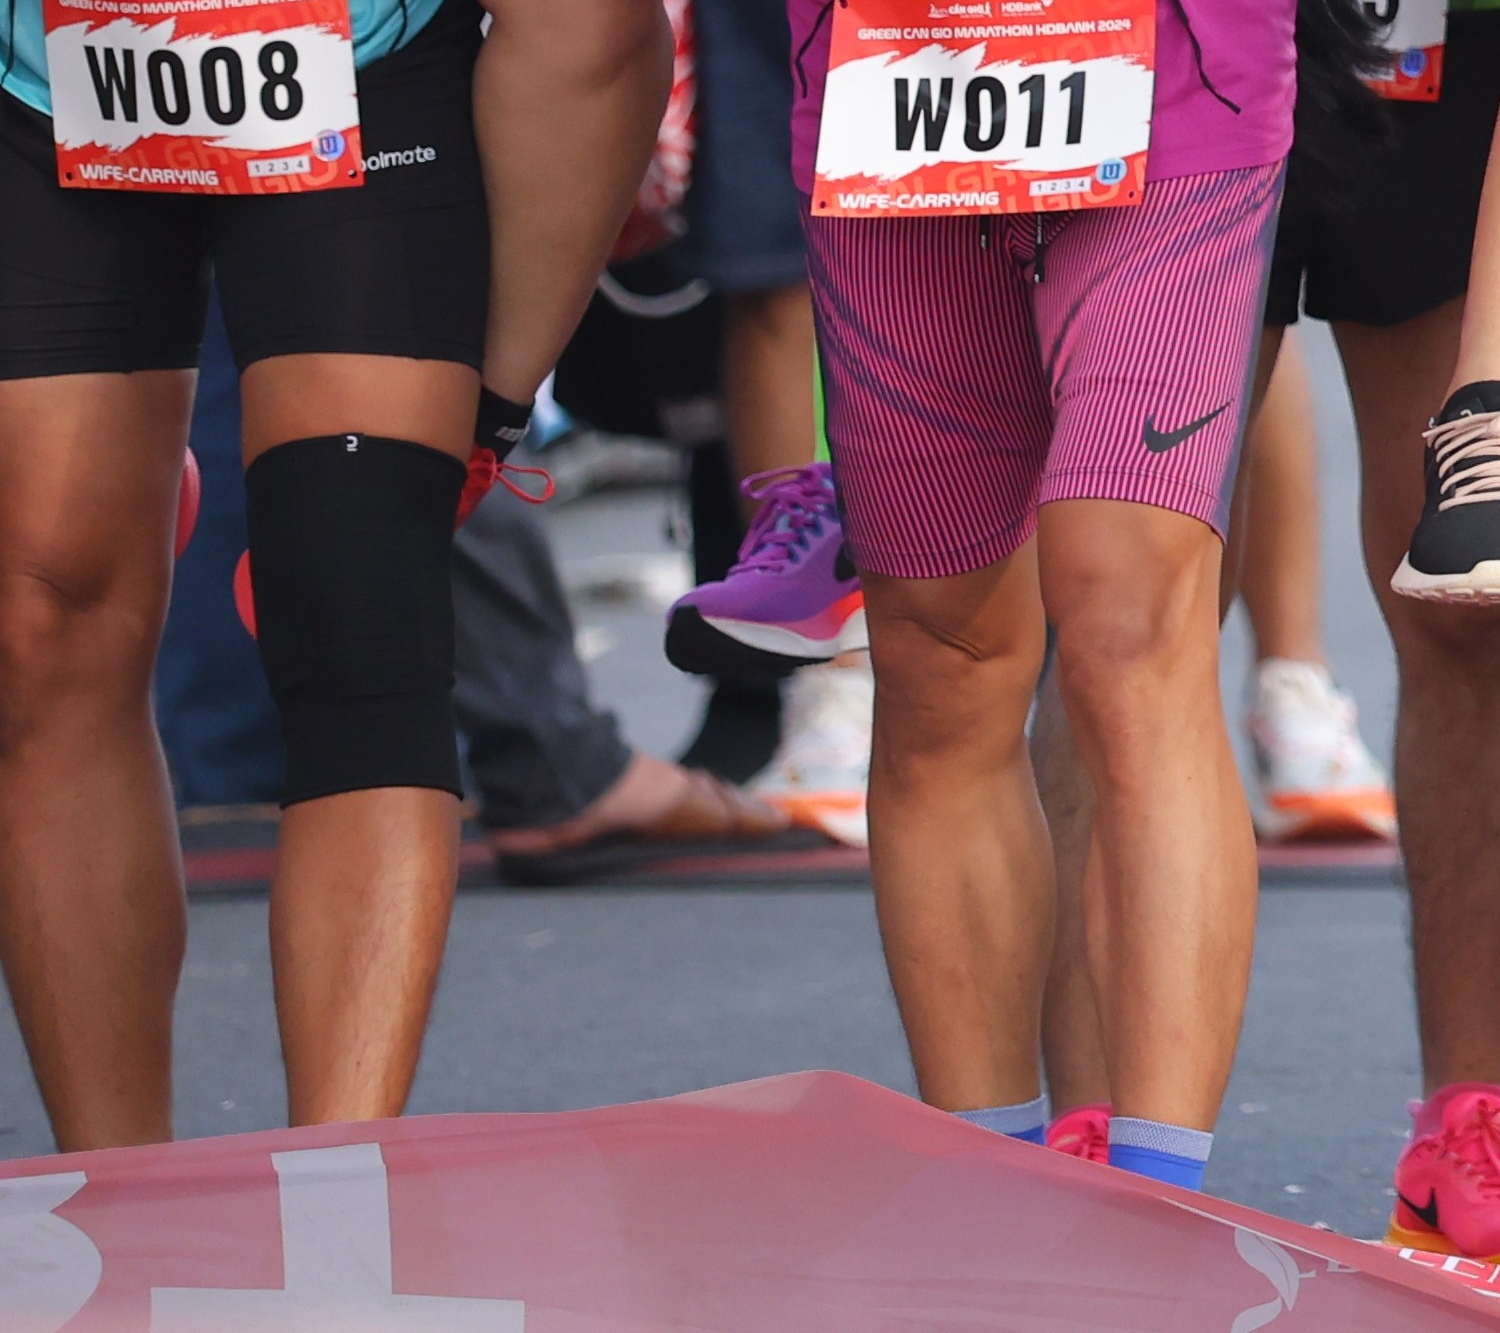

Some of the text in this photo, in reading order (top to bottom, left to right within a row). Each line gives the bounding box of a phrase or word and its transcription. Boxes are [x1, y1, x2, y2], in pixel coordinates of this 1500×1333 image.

[94, 1, 117, 12] CAN
[120, 3, 140, 14] GIO
[1001, 0, 1041, 13] HDBank
[857, 27, 901, 40] GREEN
[903, 26, 929, 39] CAN
[931, 27, 952, 39] GIO
[954, 24, 1030, 39] MARATHON
[1097, 18, 1131, 31] 2024
[83, 40, 304, 125] W008
[894, 71, 1086, 152] W011
[79, 163, 219, 186] WIFE-CARRYING
[838, 191, 999, 209] WIFE-CARRYING
